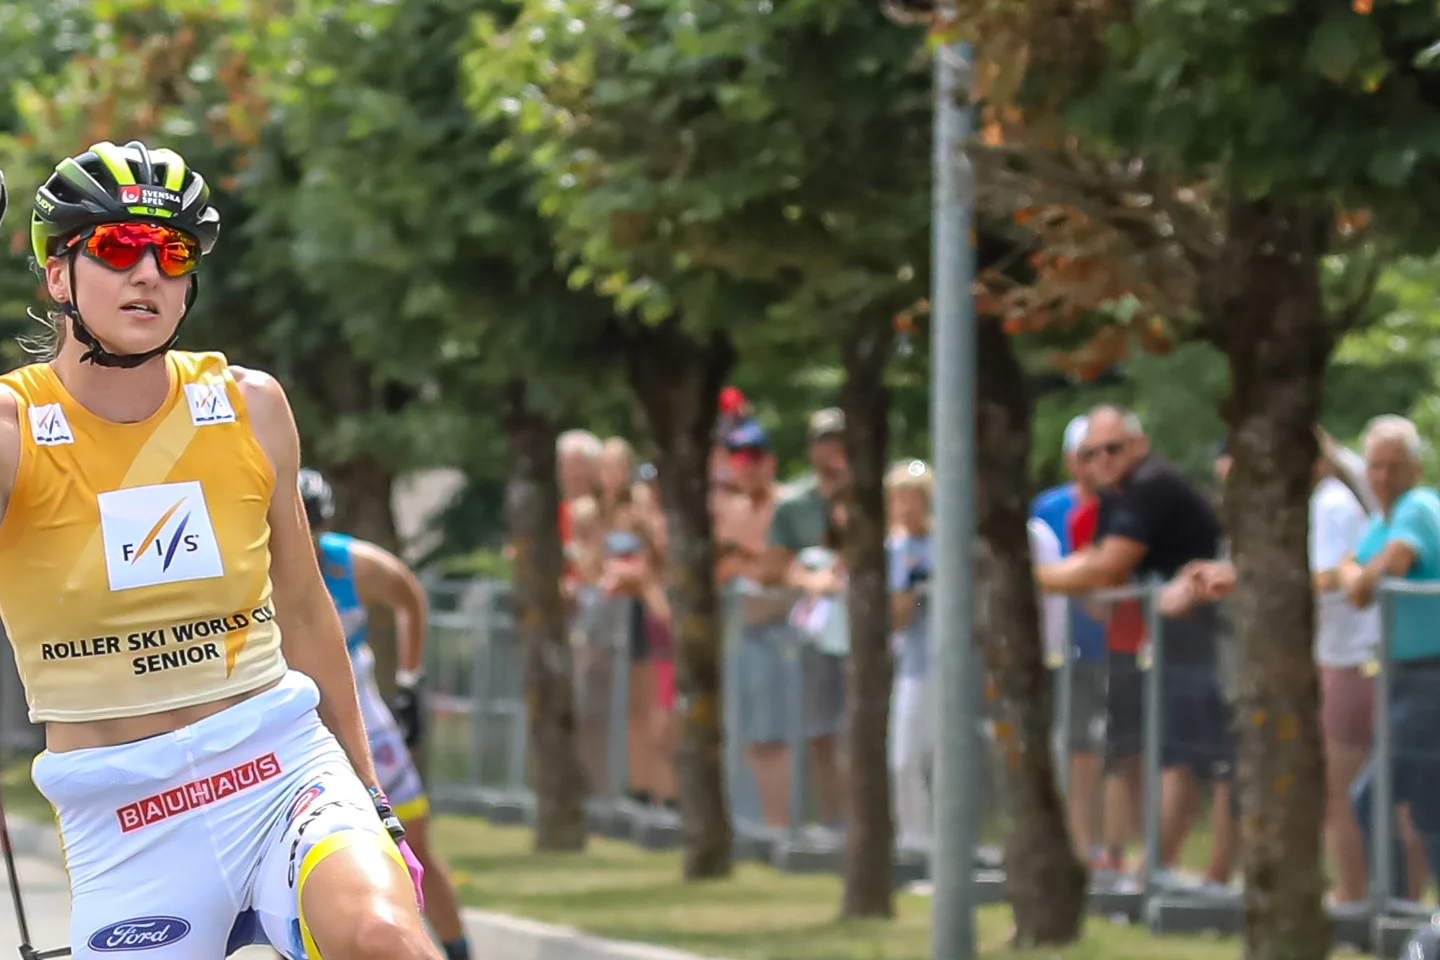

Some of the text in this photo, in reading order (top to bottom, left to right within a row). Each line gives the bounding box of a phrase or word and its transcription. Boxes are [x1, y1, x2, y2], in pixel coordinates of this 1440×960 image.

[142, 189, 181, 204] SVENSKA
[142, 197, 164, 206] SPEL
[41, 636, 121, 660] ROLLER
[127, 629, 166, 651] SKI
[171, 613, 249, 643] WORLD
[132, 642, 220, 675] SENIOR
[120, 757, 278, 829] BAUHAUS
[106, 921, 171, 947] Ford
